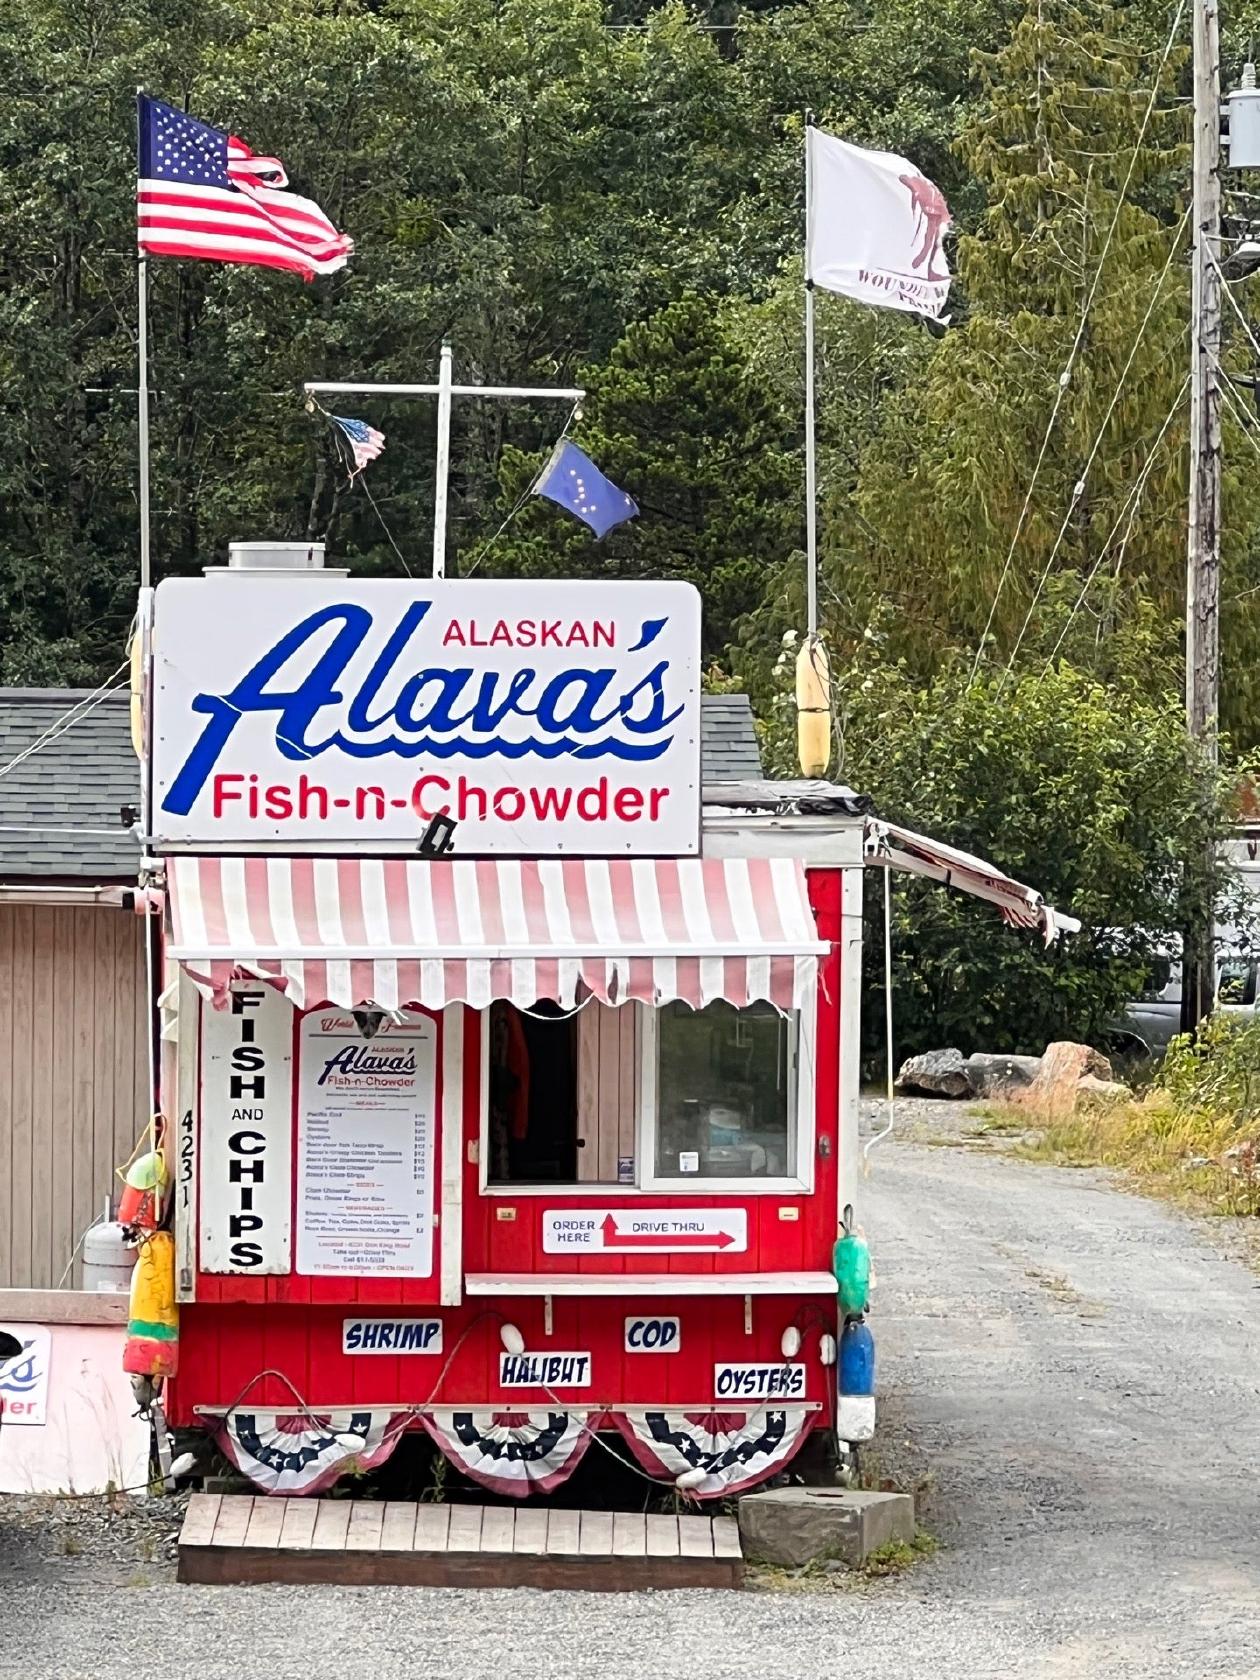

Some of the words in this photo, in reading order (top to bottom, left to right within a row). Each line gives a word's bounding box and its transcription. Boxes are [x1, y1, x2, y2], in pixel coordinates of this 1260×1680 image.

[443, 619, 615, 648] ALASKAN
[160, 600, 685, 817] Alava's
[213, 774, 671, 822] Fish-n-Chowder
[230, 990, 266, 1100] FISH
[317, 1045, 418, 1086] Alava's
[327, 1075, 417, 1087] Fish-n-Chowder
[231, 1107, 265, 1122] AND
[180, 1109, 195, 1208] 4231
[227, 1130, 267, 1268] CHIPS
[552, 1220, 596, 1231] ORDER
[557, 1232, 591, 1243] HERE
[632, 1222, 669, 1233] DRIVE
[672, 1222, 705, 1232] THRU
[346, 1322, 440, 1350] SHRIMP
[628, 1320, 677, 1348] COD
[501, 1355, 589, 1384] HALIBUT
[717, 1367, 803, 1395] OYSTERS
